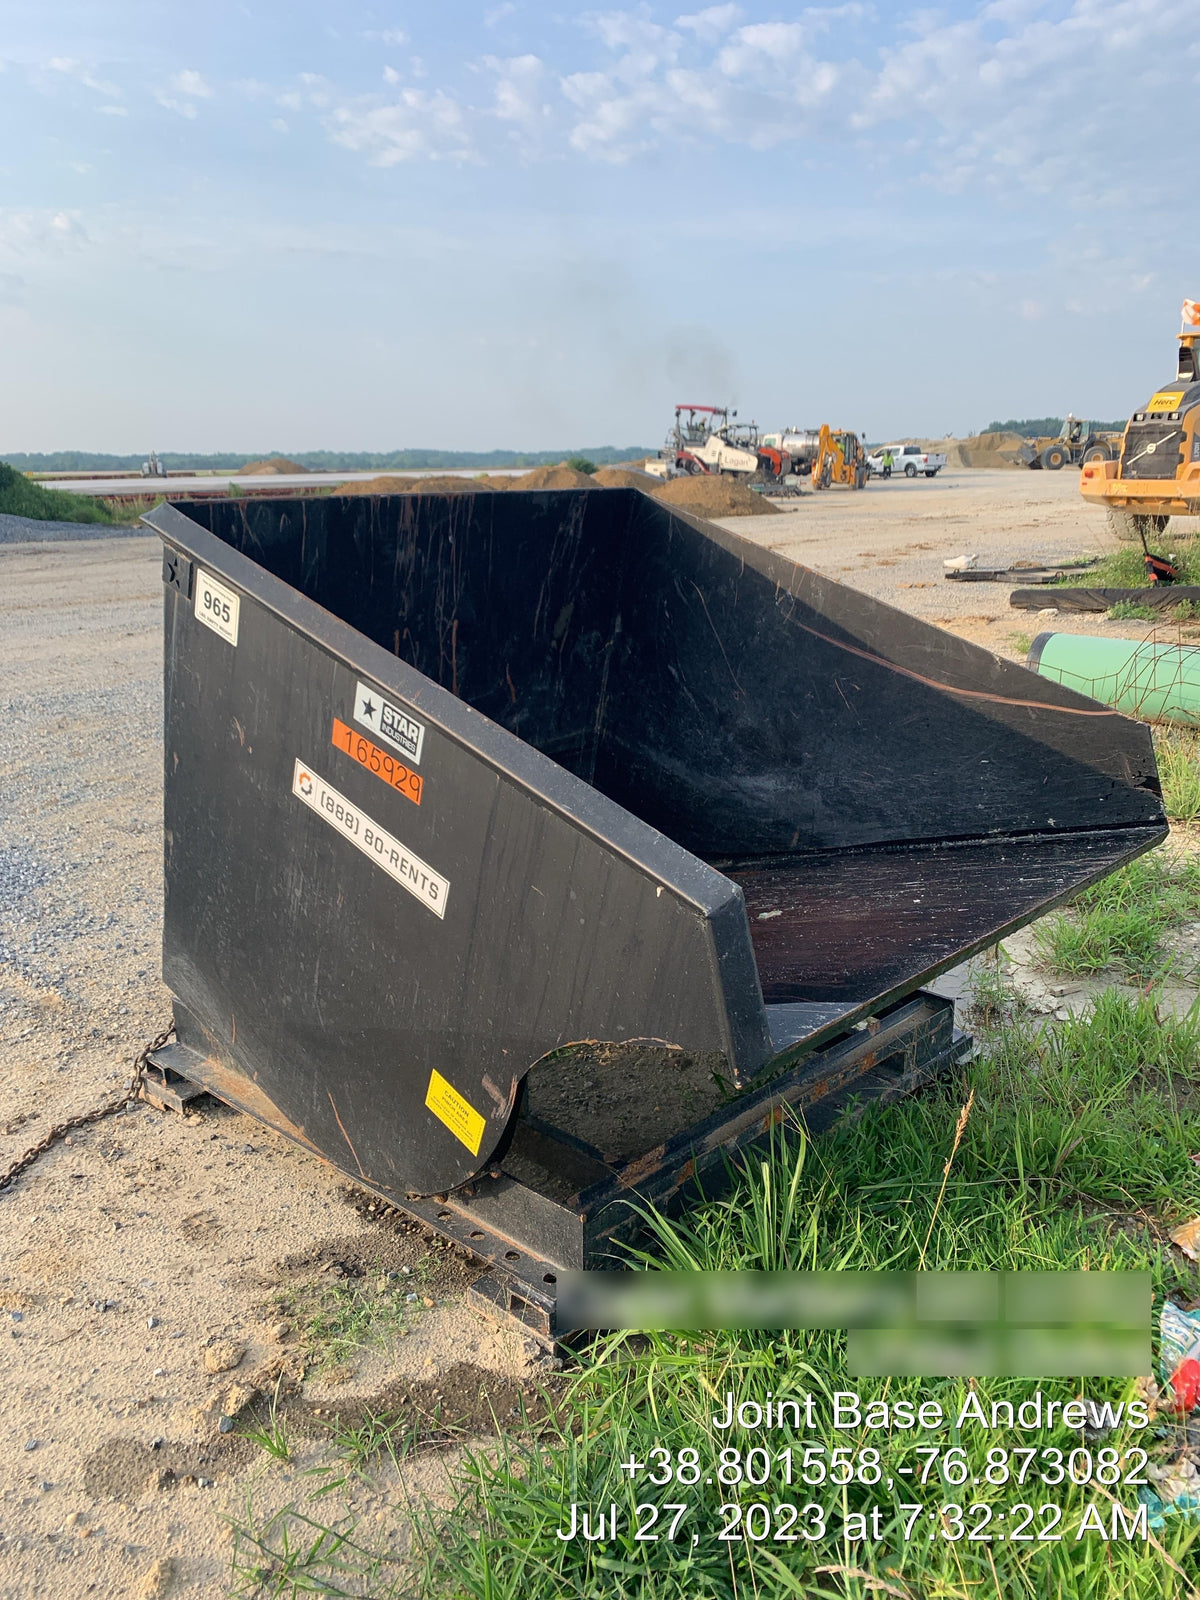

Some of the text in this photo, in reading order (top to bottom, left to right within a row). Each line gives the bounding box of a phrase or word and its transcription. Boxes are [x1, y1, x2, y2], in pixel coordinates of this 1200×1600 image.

[203, 590, 231, 623] 965
[381, 723, 416, 753] INDUSTRIES
[382, 705, 420, 743] STAR
[345, 730, 421, 802] 165929
[364, 828, 439, 900] 80-RENTS
[444, 1090, 469, 1118] CAUTION
